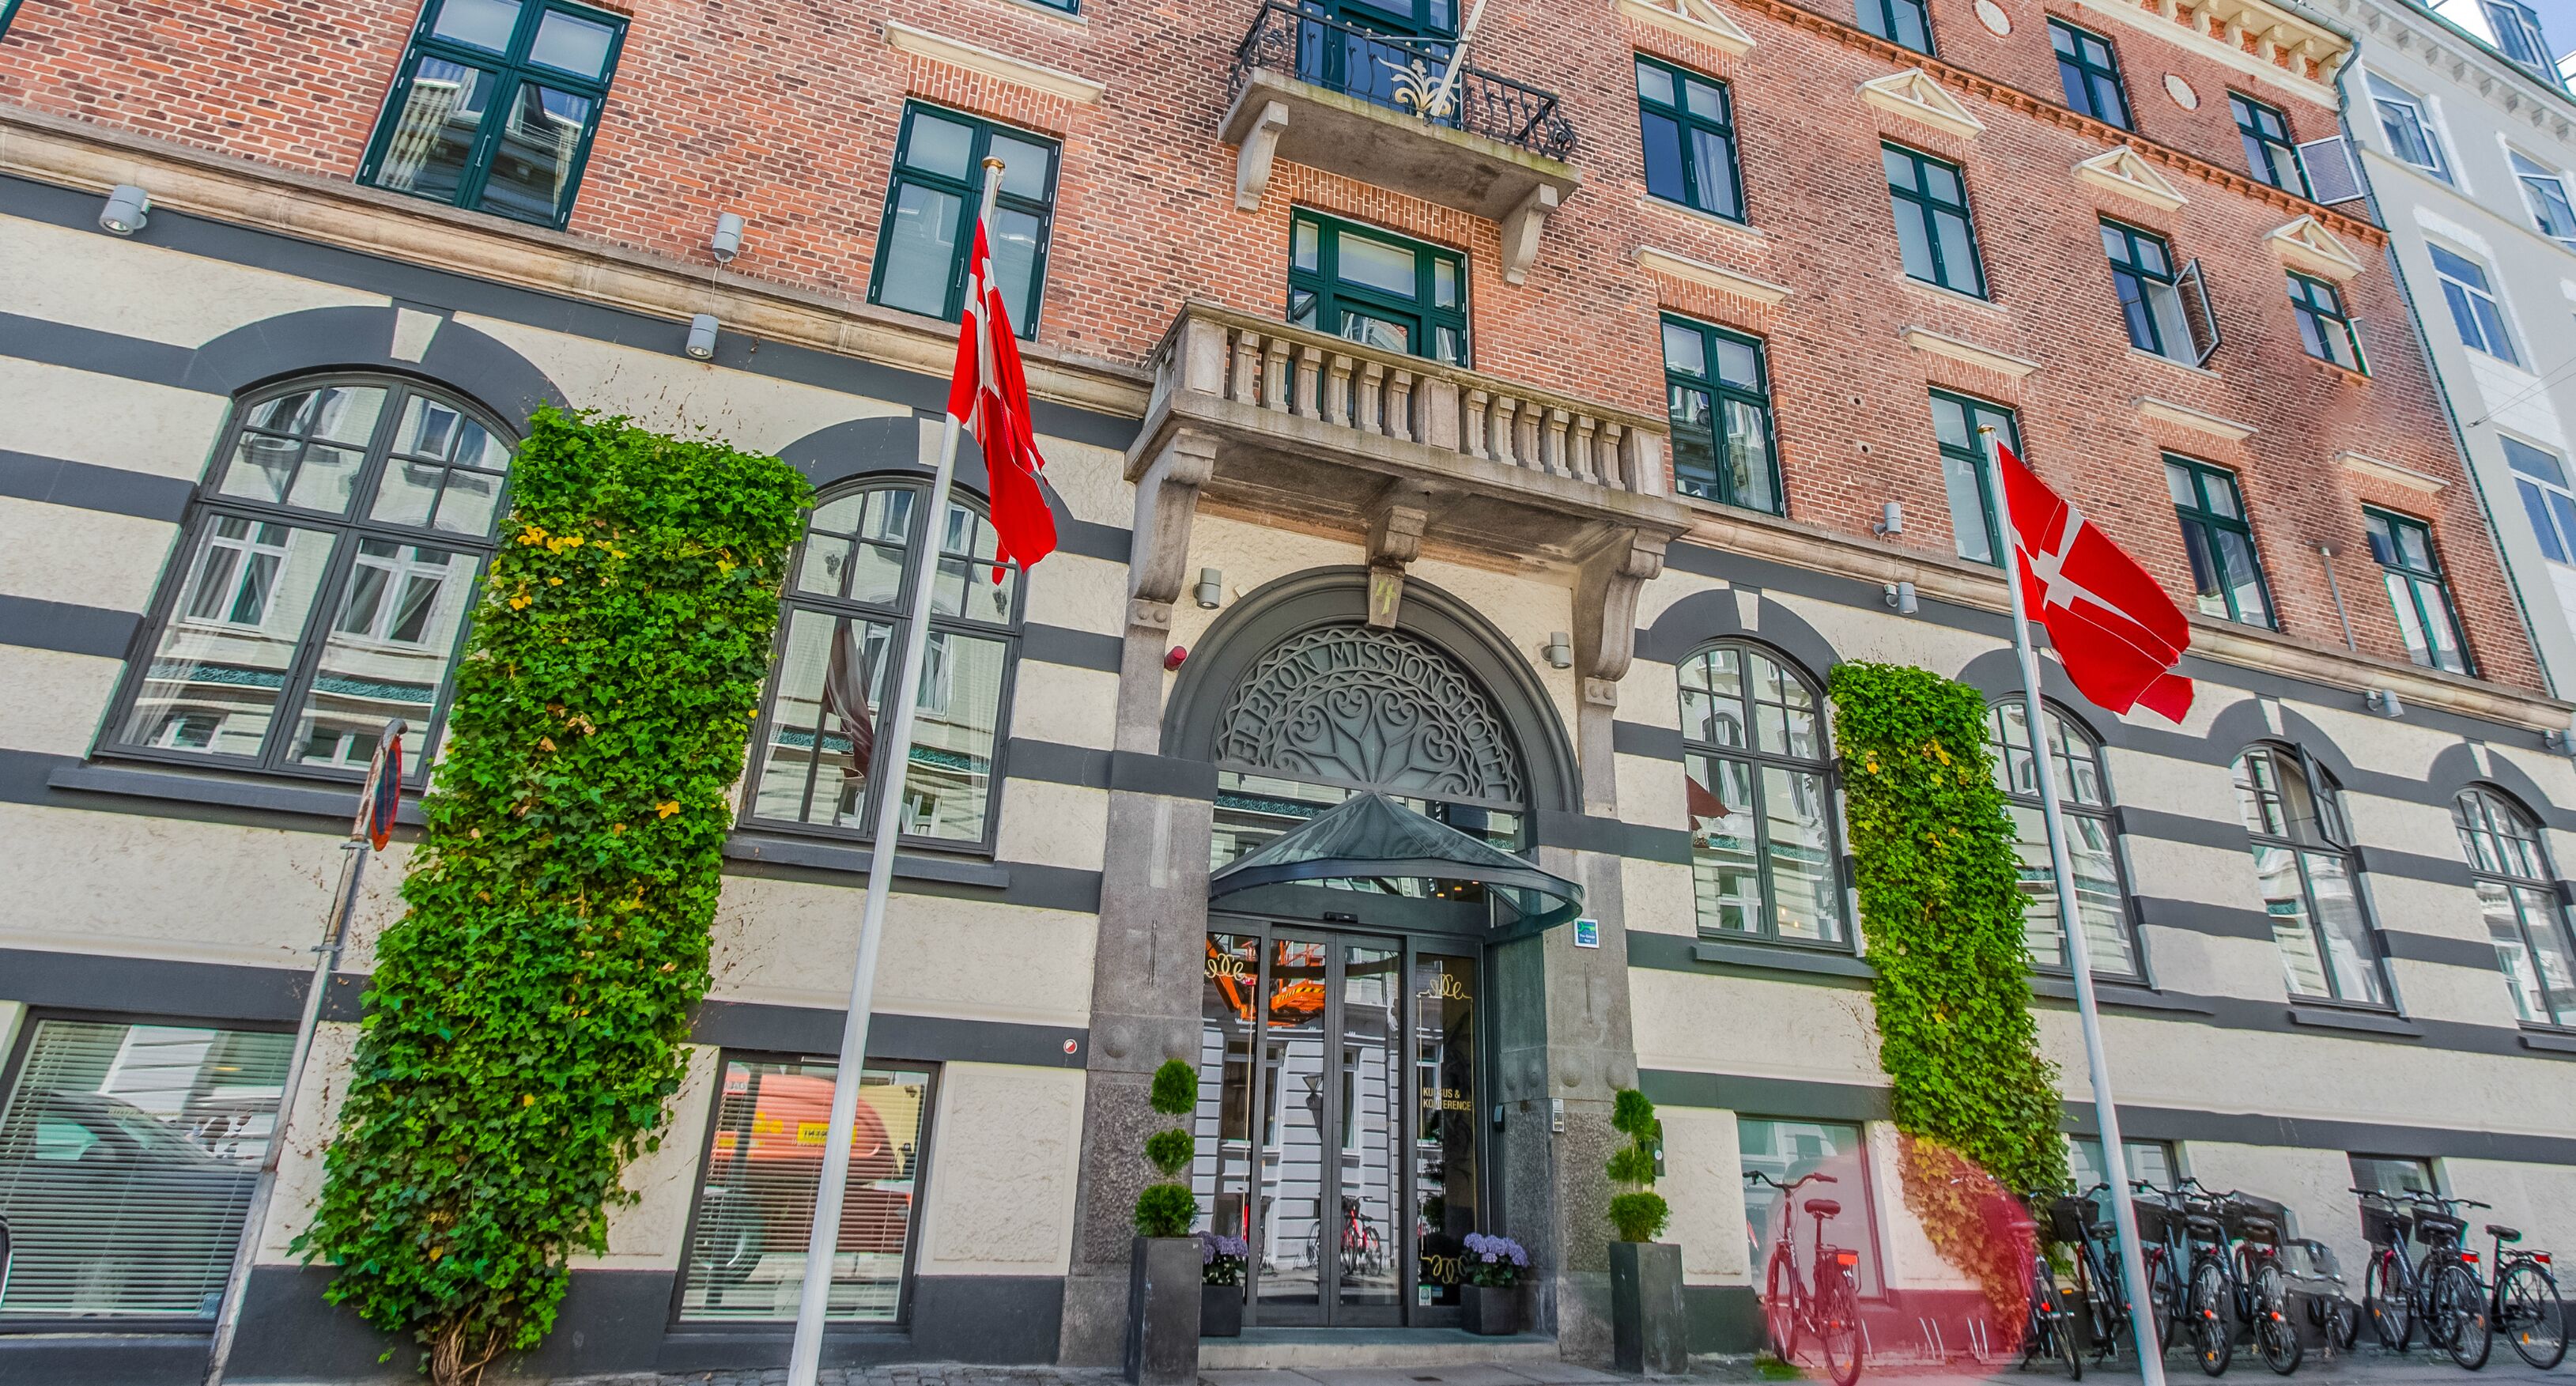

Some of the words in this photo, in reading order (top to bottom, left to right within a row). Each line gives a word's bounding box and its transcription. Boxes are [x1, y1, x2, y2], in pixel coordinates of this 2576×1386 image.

[1228, 650, 1323, 766] HEBRON
[1423, 1087, 1453, 1098] KUUS
[1455, 1089, 1460, 1099] &
[1423, 1098, 1471, 1111] KOERENCE
